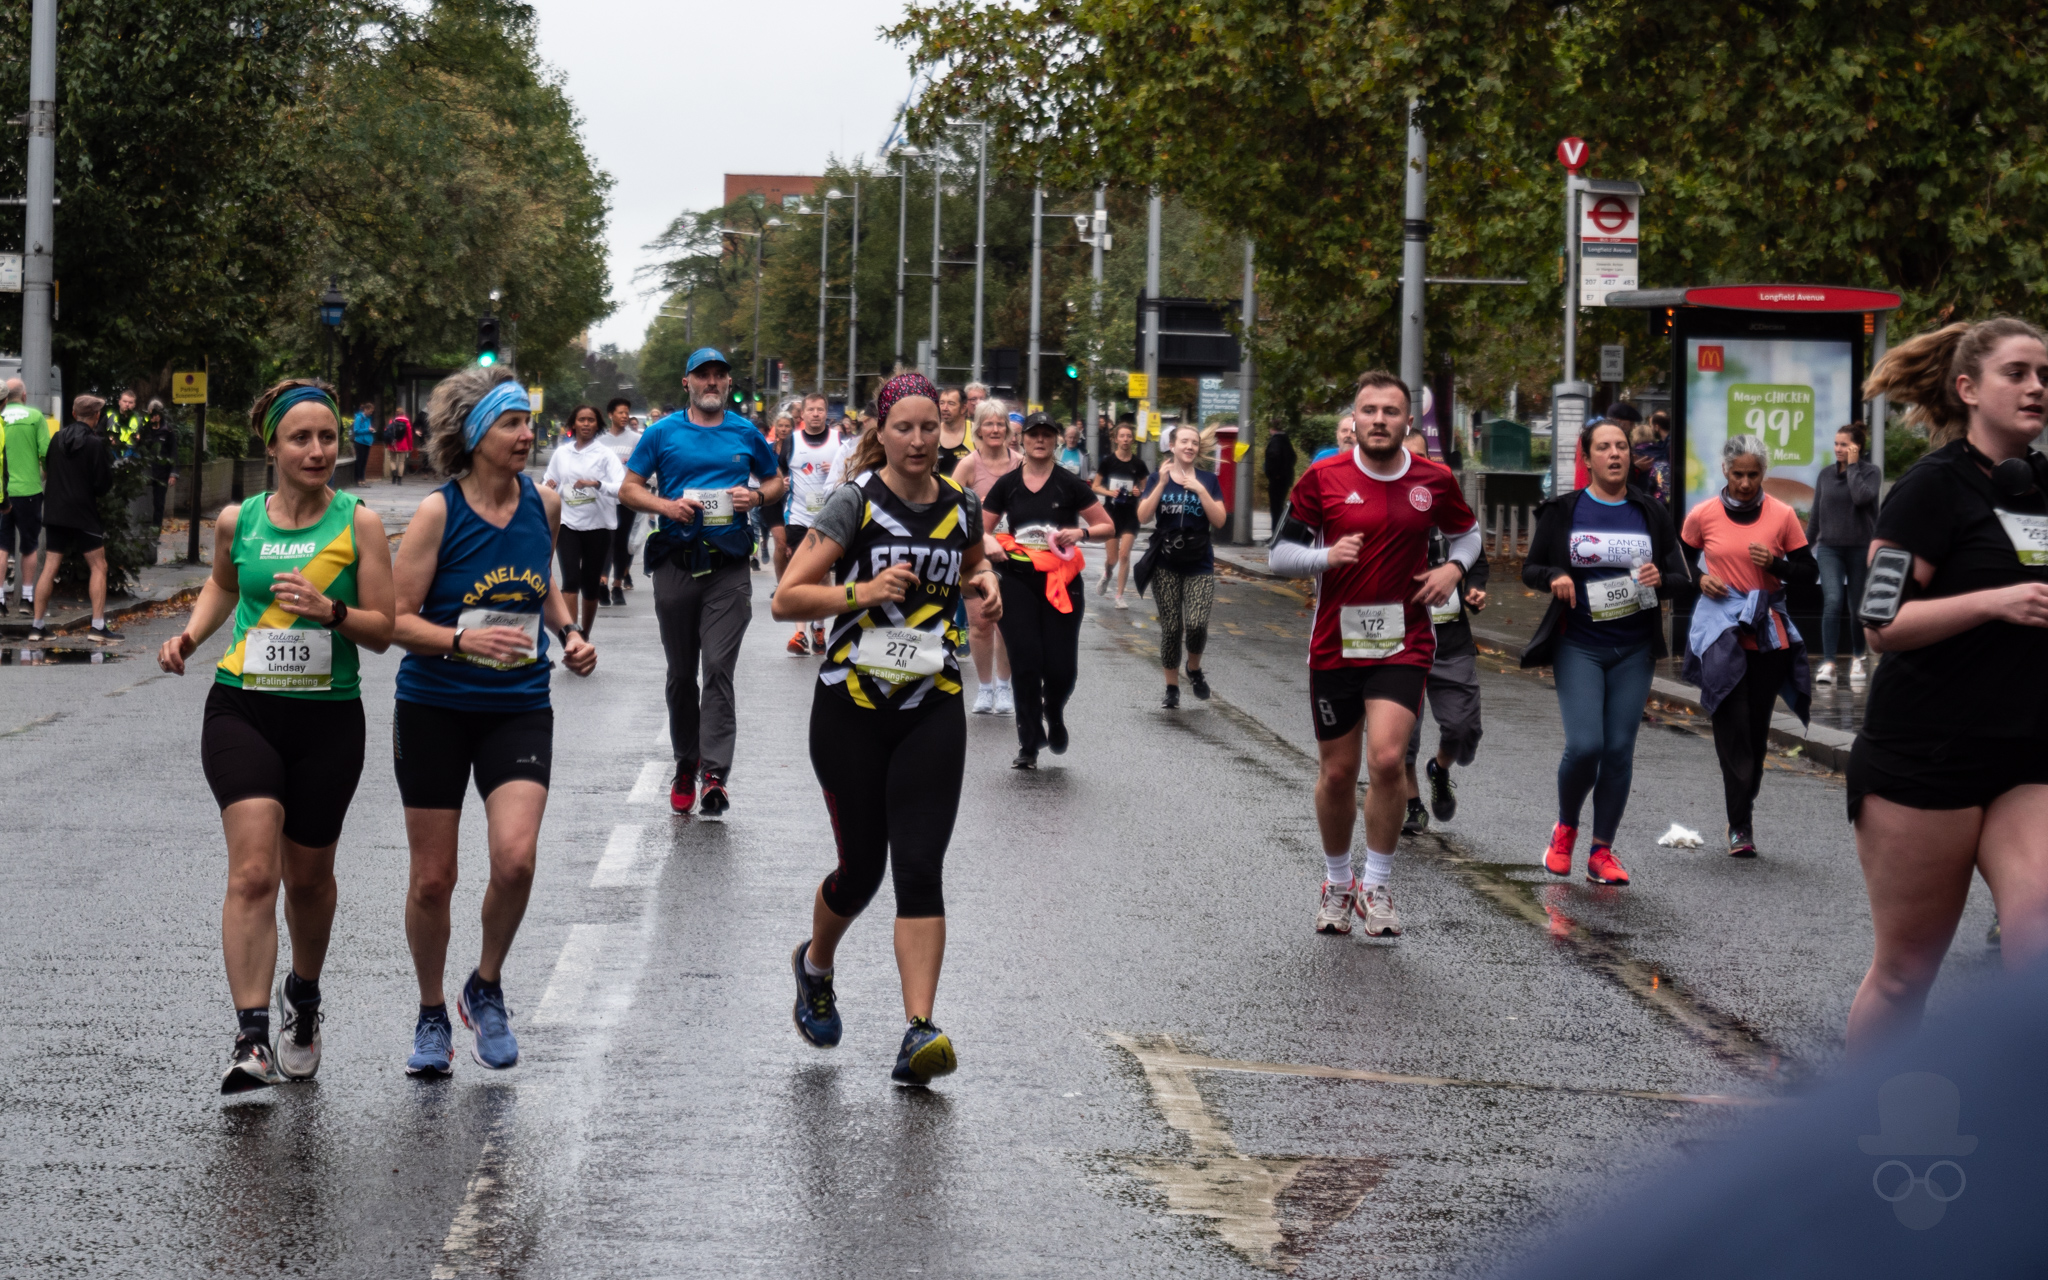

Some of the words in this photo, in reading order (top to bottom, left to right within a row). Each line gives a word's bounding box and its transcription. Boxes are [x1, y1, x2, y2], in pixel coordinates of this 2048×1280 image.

[1564, 142, 1584, 165] V
[1760, 293, 1796, 303] Longfield
[1797, 293, 1825, 302] Avenue
[1734, 391, 1763, 404] Mayo
[1765, 390, 1810, 404] CHICKEN
[1773, 451, 1800, 461] Menu
[260, 542, 316, 555] EALING
[1608, 539, 1648, 548] CANCER
[1608, 547, 1652, 558] RESERCH
[1608, 555, 1622, 563] UK
[462, 566, 548, 606] RANELAGH
[1607, 588, 1628, 601] 950
[1360, 619, 1384, 631] 172
[266, 645, 310, 661] 3113
[886, 642, 918, 660] 277
[268, 664, 306, 673] Lindsay
[895, 659, 907, 668] Ali
[256, 677, 318, 687] #EalingFeeling
